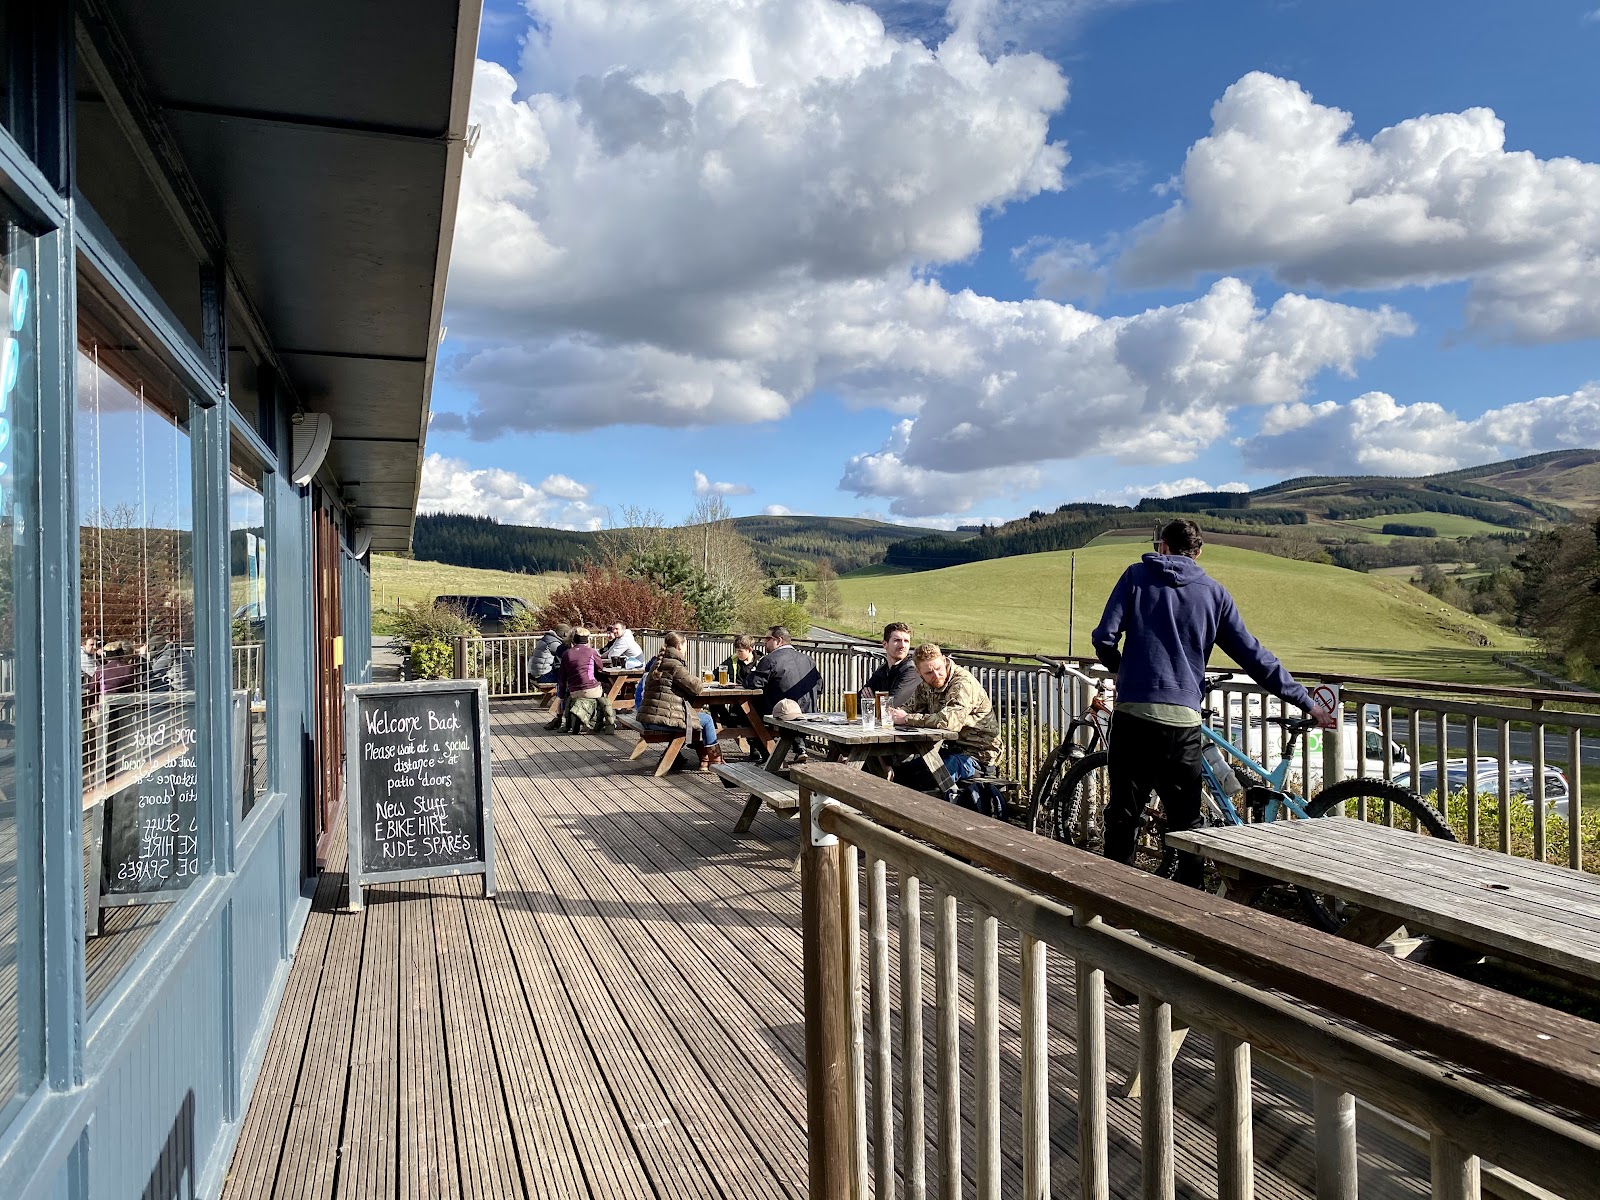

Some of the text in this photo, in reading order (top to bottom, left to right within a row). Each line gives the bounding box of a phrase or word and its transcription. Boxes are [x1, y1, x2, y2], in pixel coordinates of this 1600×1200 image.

[365, 709, 461, 741] Welcome Back
[365, 735, 470, 761] Please wait at a social
[394, 753, 459, 781] distance at
[387, 774, 452, 796] patio doors
[376, 802, 406, 821] New
[1057, 801, 1065, 838] MAXXIS
[418, 815, 452, 837] HIRE
[382, 834, 471, 859] RIDE SPARES
